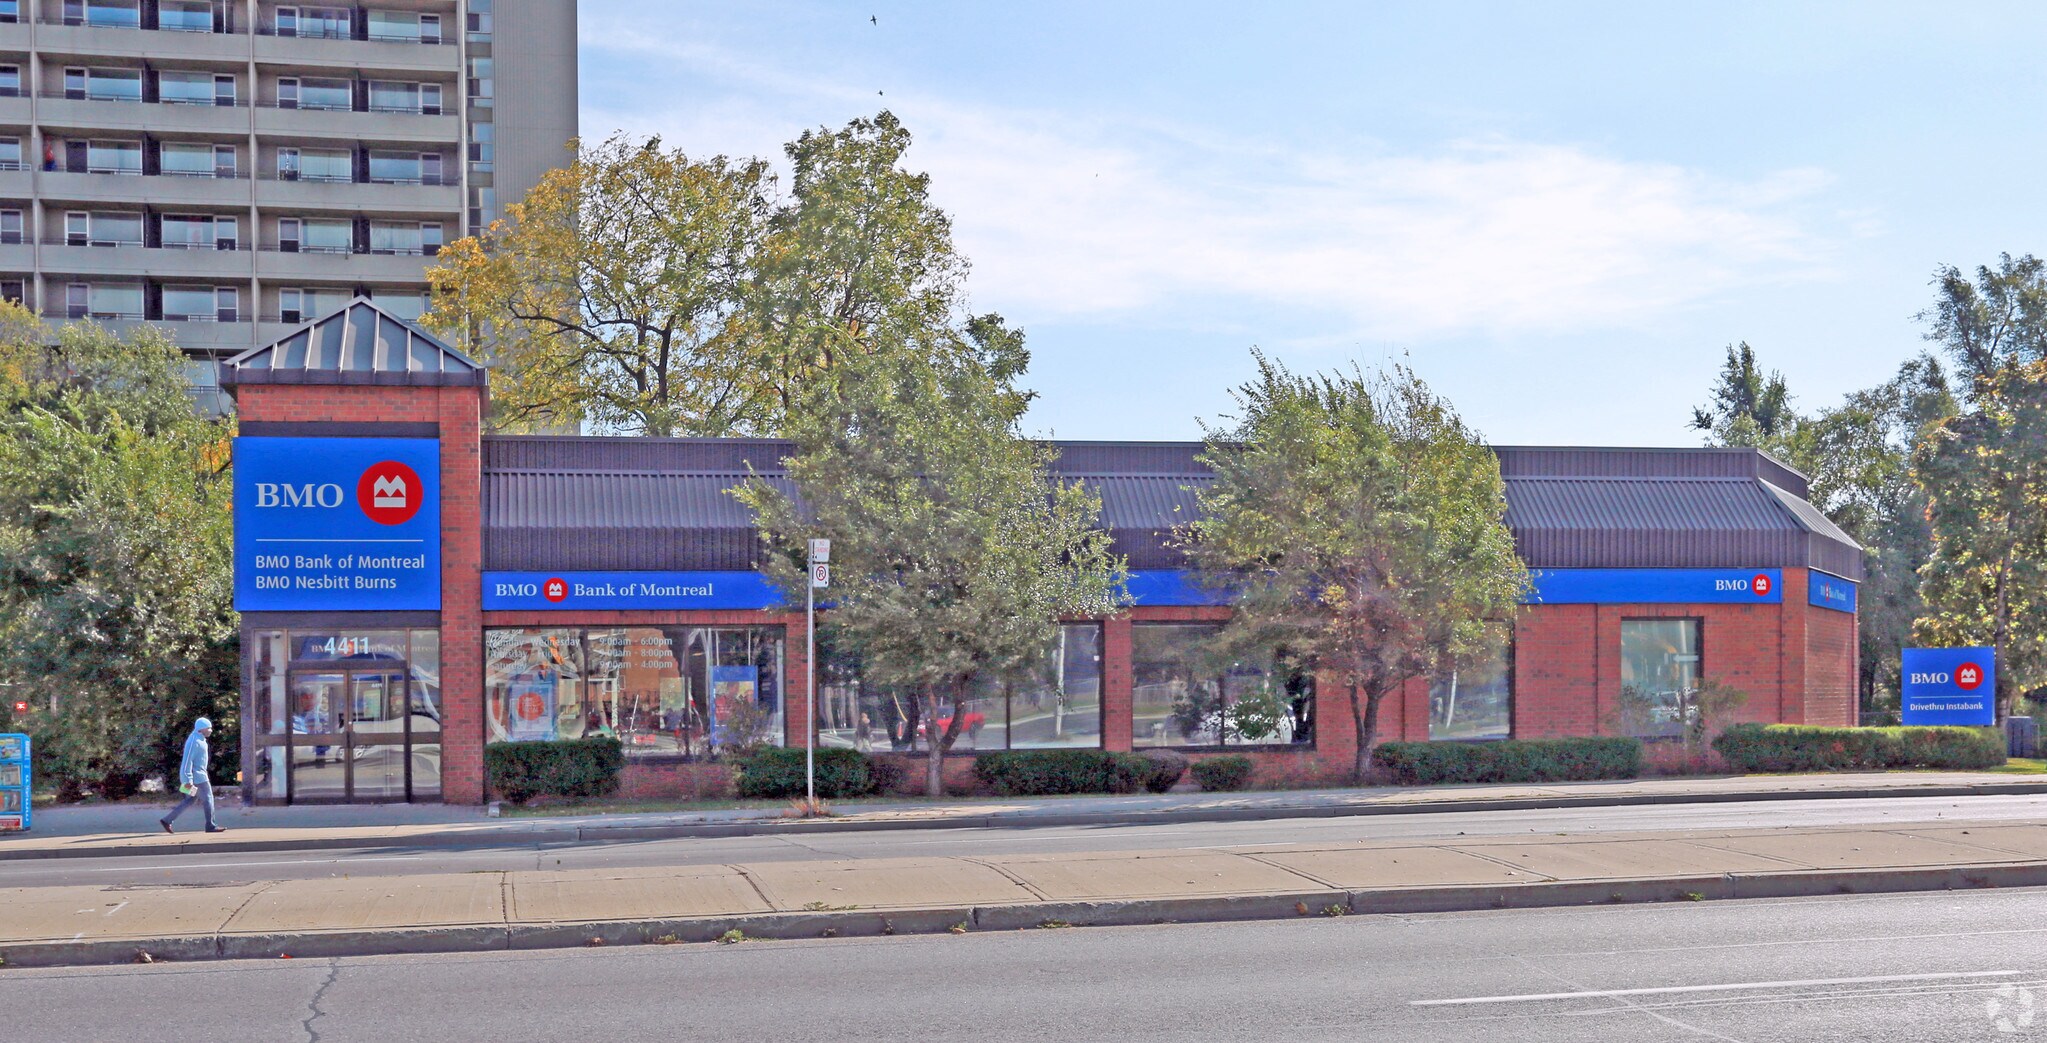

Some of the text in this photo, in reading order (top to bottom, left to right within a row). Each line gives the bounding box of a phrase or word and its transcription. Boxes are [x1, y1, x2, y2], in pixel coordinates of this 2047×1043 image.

[255, 483, 344, 508] BMO
[255, 554, 425, 569] BMO Bank of Montreal
[256, 574, 397, 589] BMO Nesbitt Burns
[1716, 579, 1748, 591] BMO
[495, 583, 713, 597] BMO Bank of Montreal
[324, 636, 369, 655] 4411
[531, 637, 581, 648] Wednesday
[600, 637, 632, 646] 9:00am
[641, 637, 673, 647] 6:00pm
[397, 645, 436, 653] Mntreal
[641, 649, 673, 658] 8:00pm
[600, 660, 632, 668] 9:00am
[641, 660, 673, 670] 4:00pm
[1910, 672, 1949, 684] BMO
[1909, 702, 1984, 711] Drivethru Instabank
